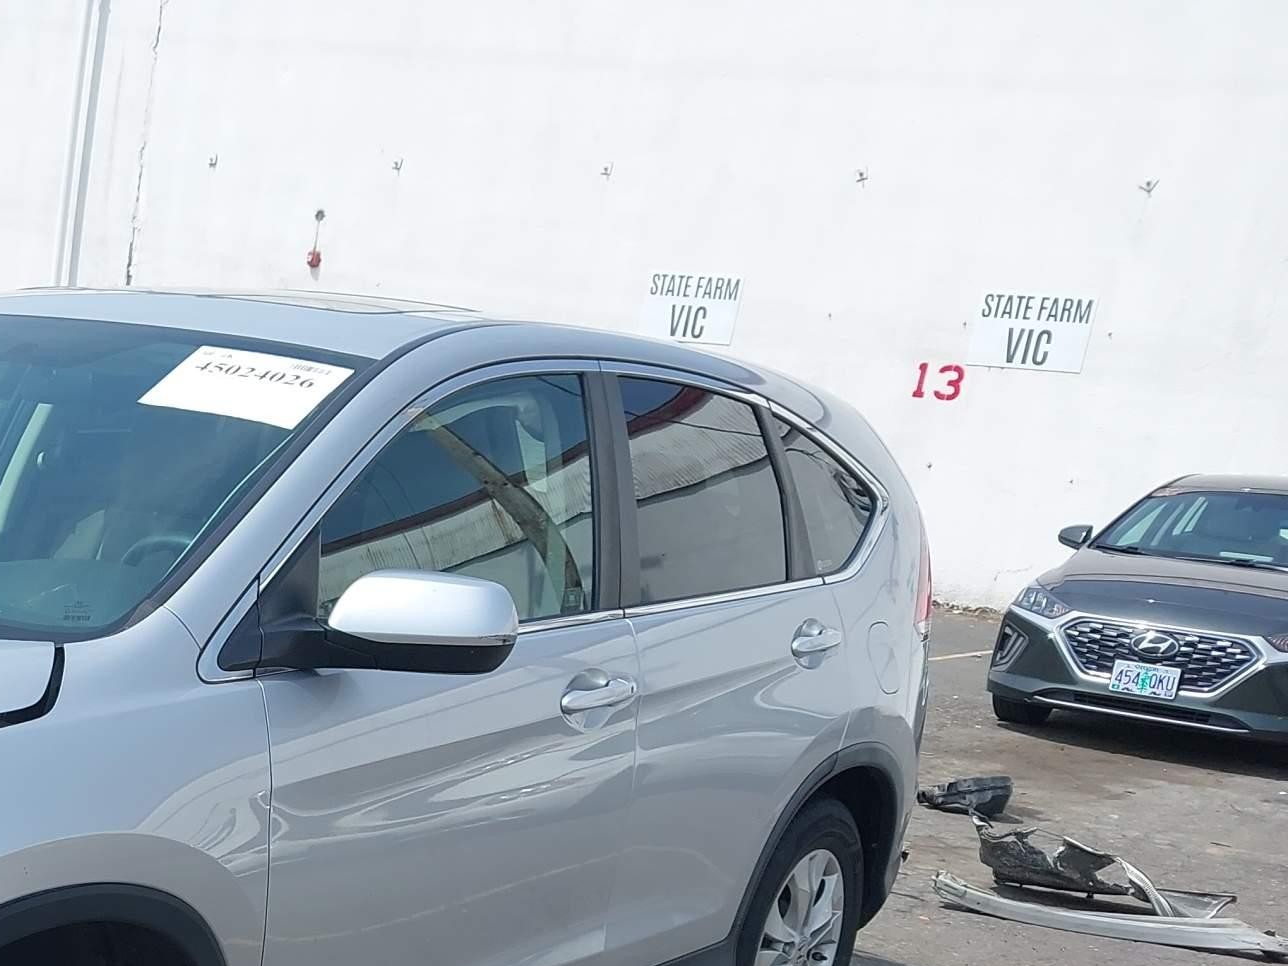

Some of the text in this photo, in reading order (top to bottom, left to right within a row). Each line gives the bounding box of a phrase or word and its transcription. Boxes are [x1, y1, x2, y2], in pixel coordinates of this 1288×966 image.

[649, 273, 742, 301] STATE FARM
[669, 303, 708, 339] VIC
[981, 293, 1095, 325] STATE FARM
[1005, 327, 1053, 367] VIC
[195, 360, 316, 390] 45024026
[911, 361, 966, 401] 13
[1114, 668, 1142, 687] 454
